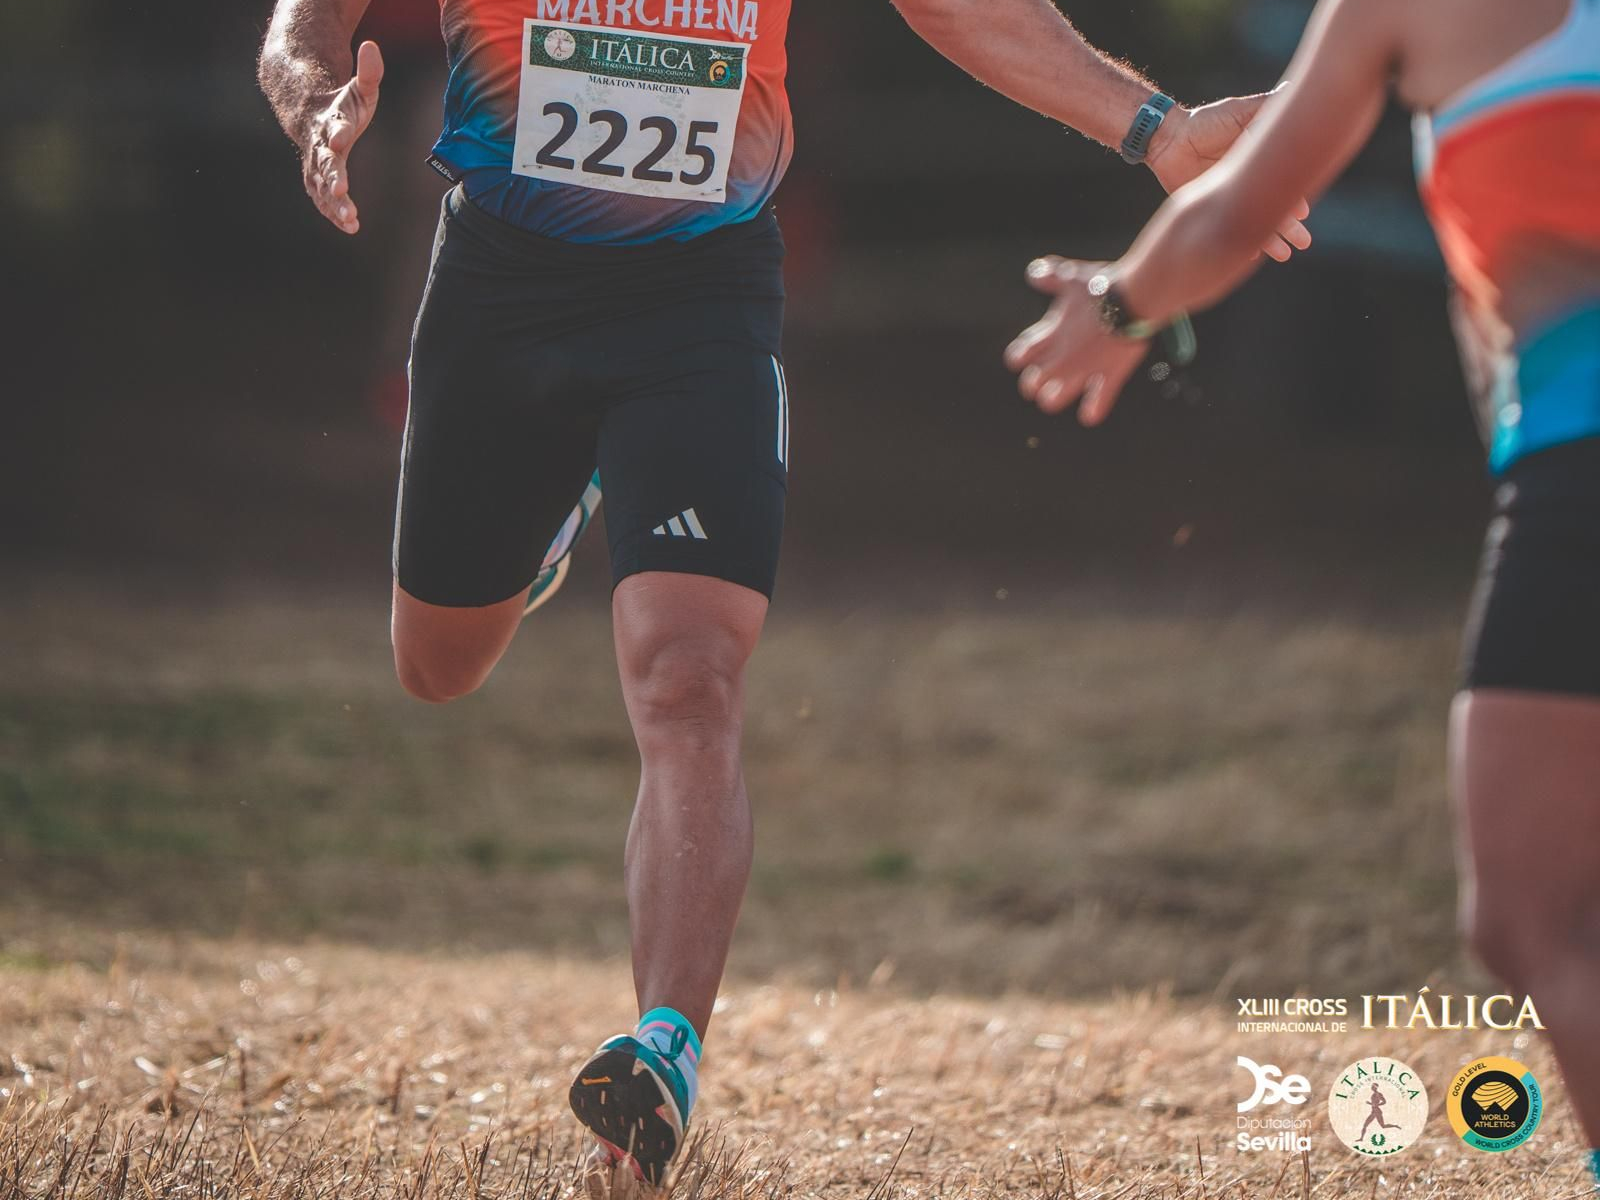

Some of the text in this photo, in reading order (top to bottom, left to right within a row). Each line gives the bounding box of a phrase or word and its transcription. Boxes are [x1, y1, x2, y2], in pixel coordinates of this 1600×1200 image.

[590, 36, 696, 71] ITÁLICA
[588, 75, 691, 96] MARATON MARCHENA
[536, 102, 719, 187] 2225
